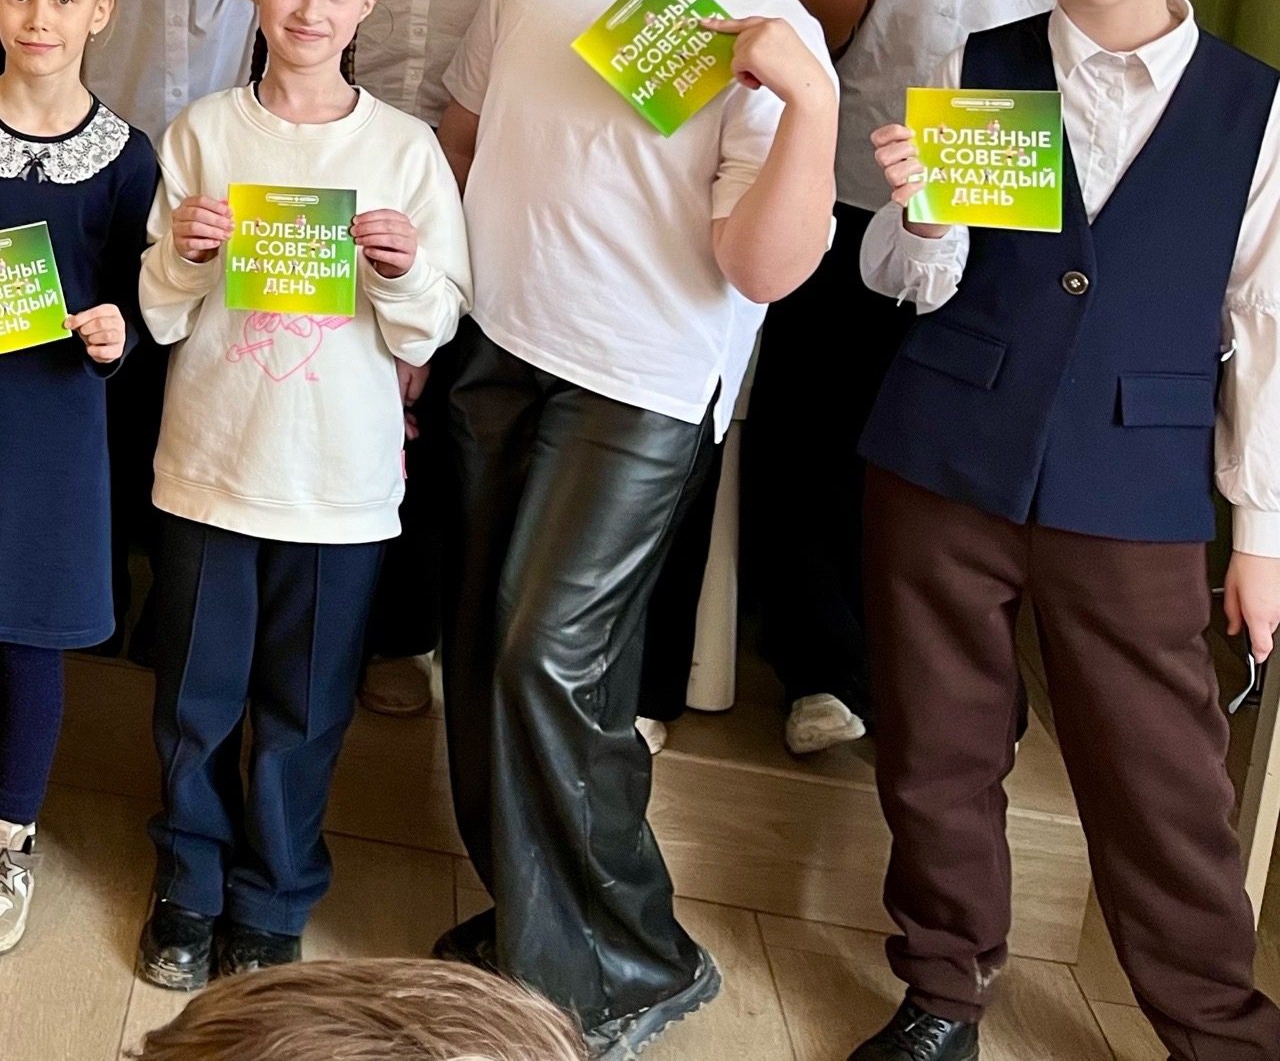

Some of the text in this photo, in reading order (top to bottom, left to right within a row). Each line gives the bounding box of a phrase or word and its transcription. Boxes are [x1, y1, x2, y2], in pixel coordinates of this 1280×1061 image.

[637, 10, 703, 74] СОВЕТЫ
[672, 54, 716, 98] ДЕНЬ
[632, 78, 661, 105] НА
[923, 127, 1052, 148] ПОЛЕЗНЫЕ
[940, 148, 1037, 167] СОВЕТЫ
[950, 167, 1056, 189] КАЖДЫЙ
[951, 187, 1014, 206] ДЕНЬ
[241, 220, 348, 240] ПОЛЕЗНЫЕ
[256, 240, 336, 258] СОВЕТЫ
[232, 256, 350, 279] НА КАЖДЫЙ
[264, 278, 316, 295] ДЕНЬ
